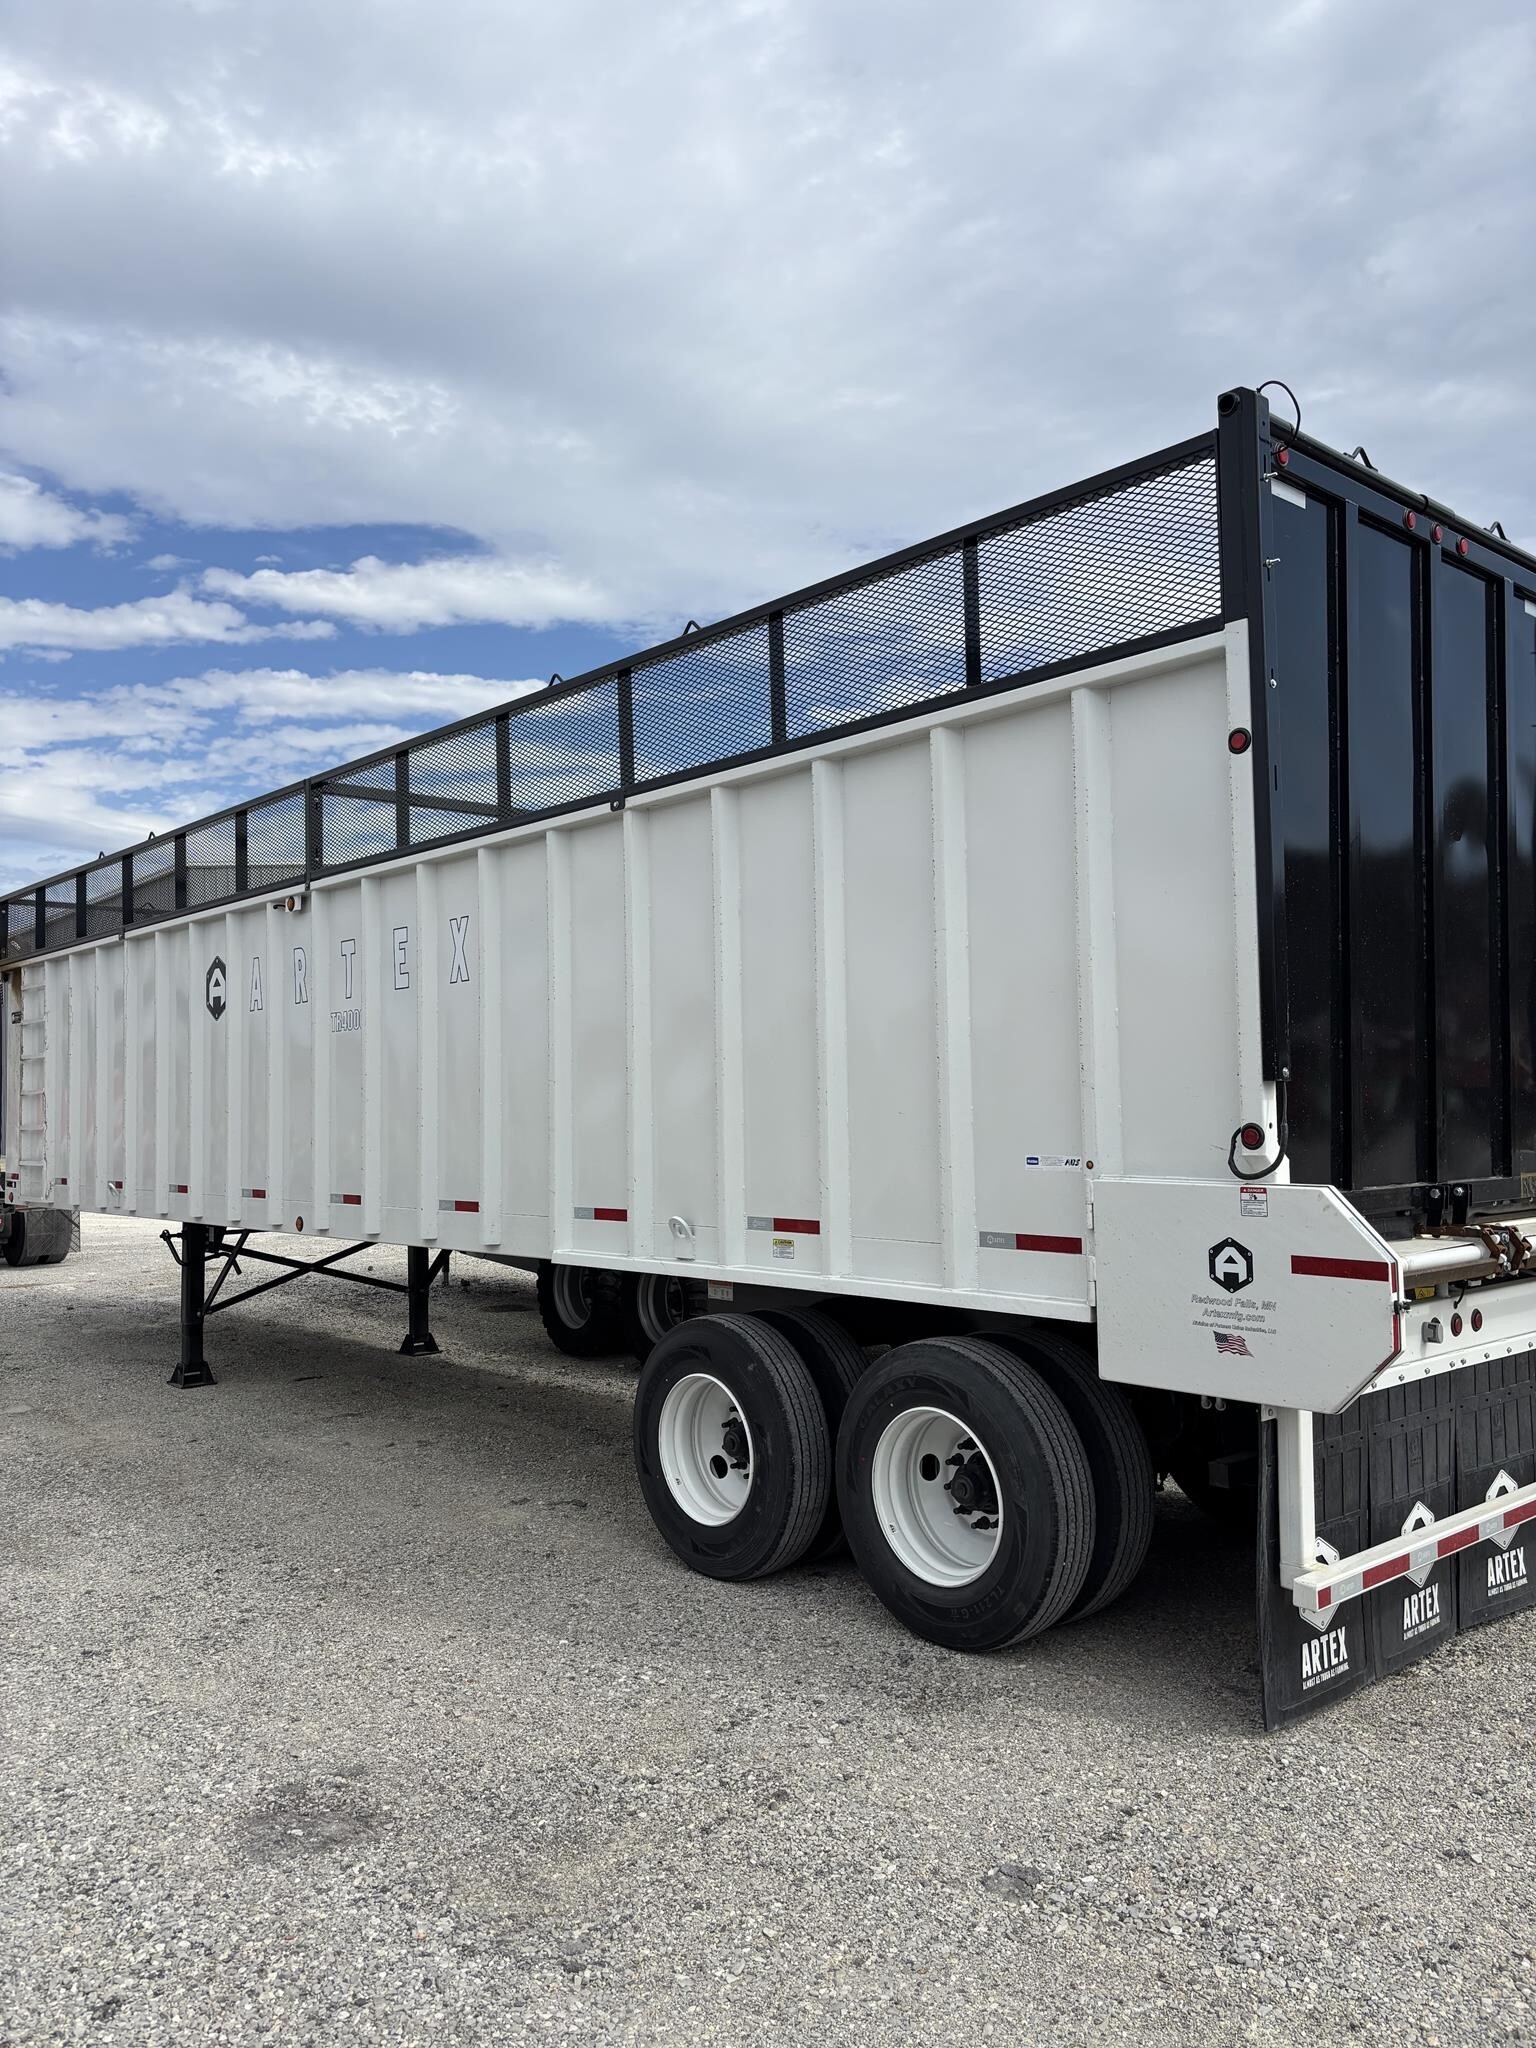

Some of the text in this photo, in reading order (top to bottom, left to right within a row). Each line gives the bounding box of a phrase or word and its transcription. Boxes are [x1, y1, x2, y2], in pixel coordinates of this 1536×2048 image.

[249, 915, 470, 1012] ARTEX
[330, 1008, 362, 1033] TR400
[1191, 1293, 1233, 1306] Redwood
[1202, 1308, 1266, 1322] Artexmfg.com
[1488, 1546, 1526, 1588] ARTEX
[1403, 1582, 1440, 1630] ARTEX
[1302, 1626, 1348, 1679] ARTEX
